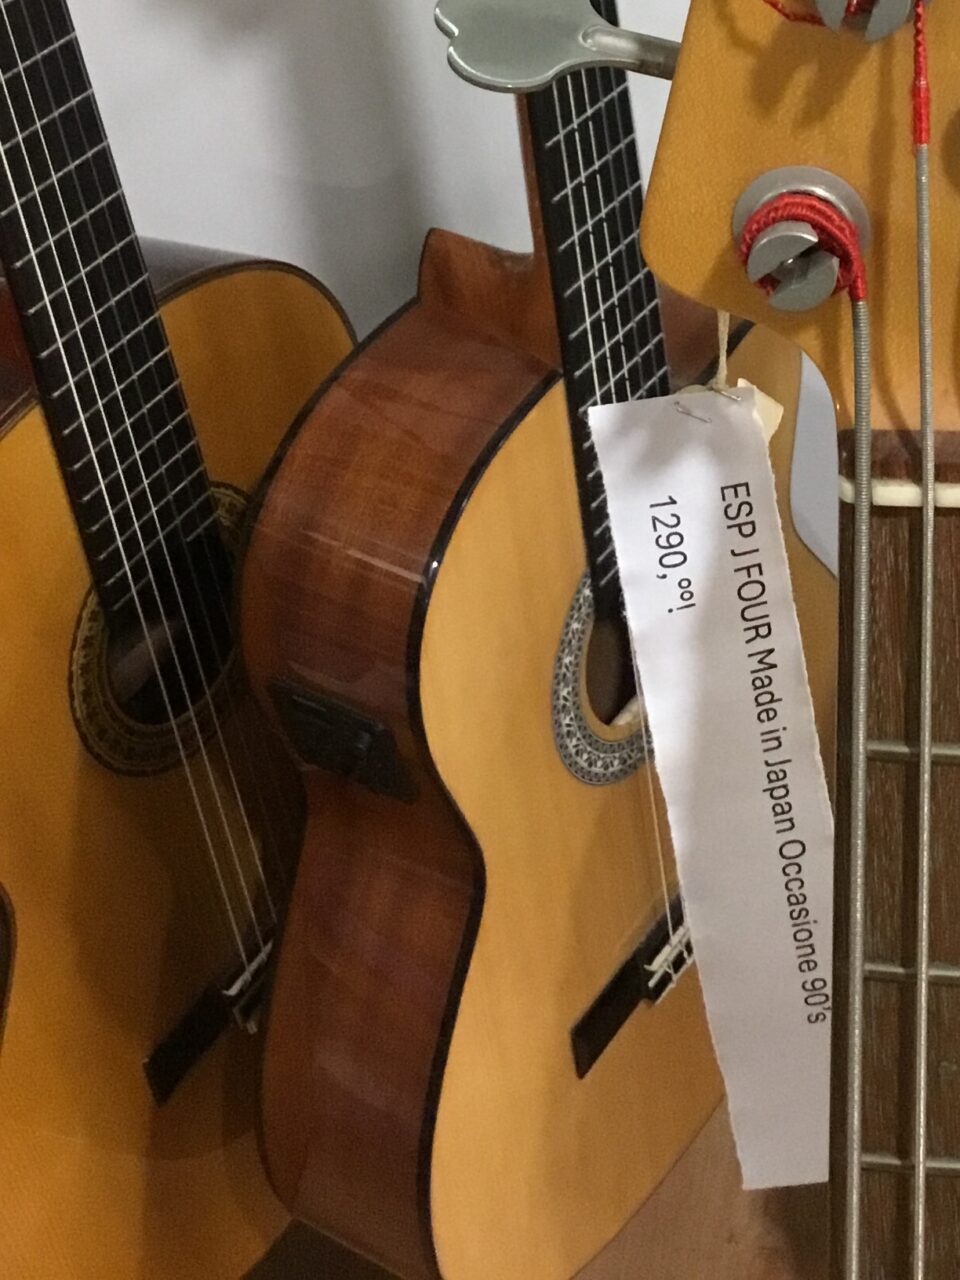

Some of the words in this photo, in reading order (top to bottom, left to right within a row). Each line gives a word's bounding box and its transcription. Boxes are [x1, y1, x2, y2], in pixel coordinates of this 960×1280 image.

[720, 480, 758, 539] ESP
[730, 547, 760, 558] J
[733, 561, 772, 645] FOUR
[748, 647, 783, 723] Made
[760, 726, 788, 753] in
[762, 758, 796, 834] Japan
[778, 839, 818, 974] Occasione
[802, 977, 833, 1025] 90's
